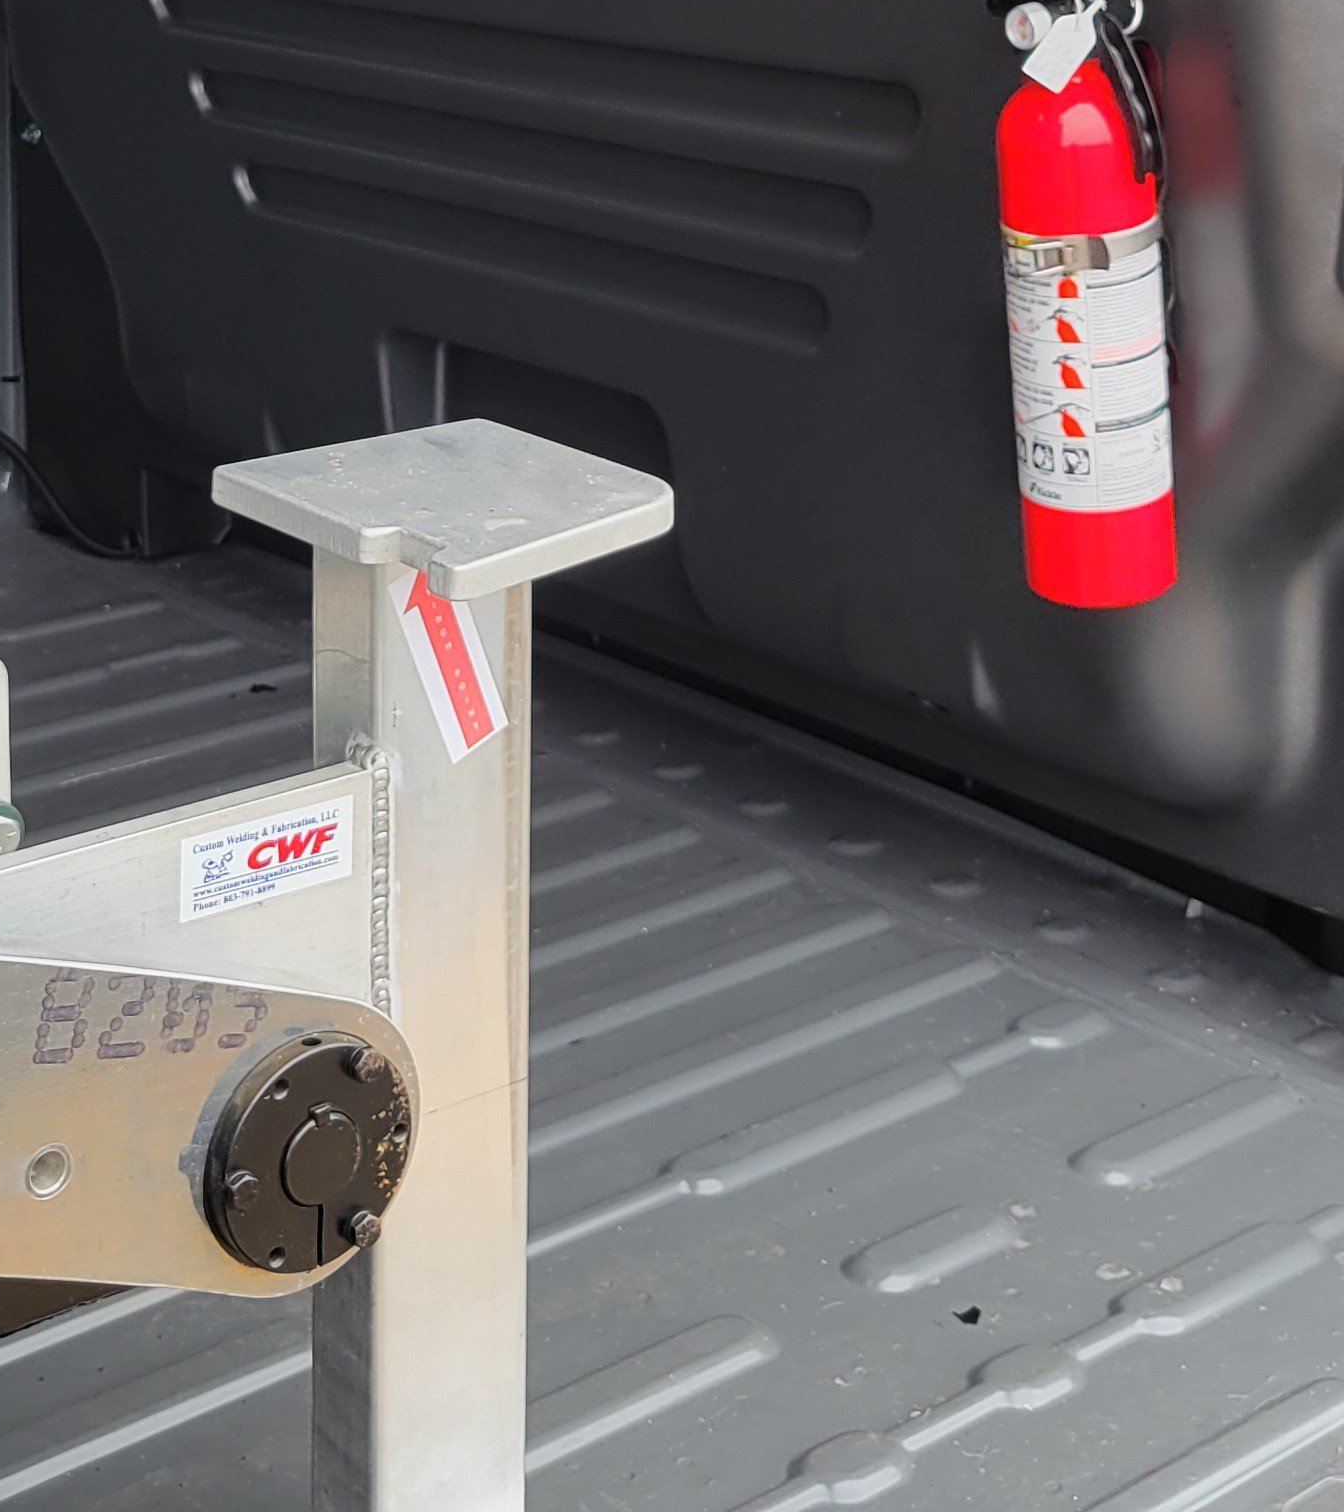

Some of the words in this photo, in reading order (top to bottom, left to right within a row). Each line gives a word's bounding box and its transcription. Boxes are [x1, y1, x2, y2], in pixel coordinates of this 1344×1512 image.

[193, 839, 224, 855] Custom
[227, 830, 260, 846] Welding
[261, 826, 269, 837] &
[320, 807, 340, 822] LLC
[247, 822, 339, 870] CWF
[193, 896, 222, 913] Phone:
